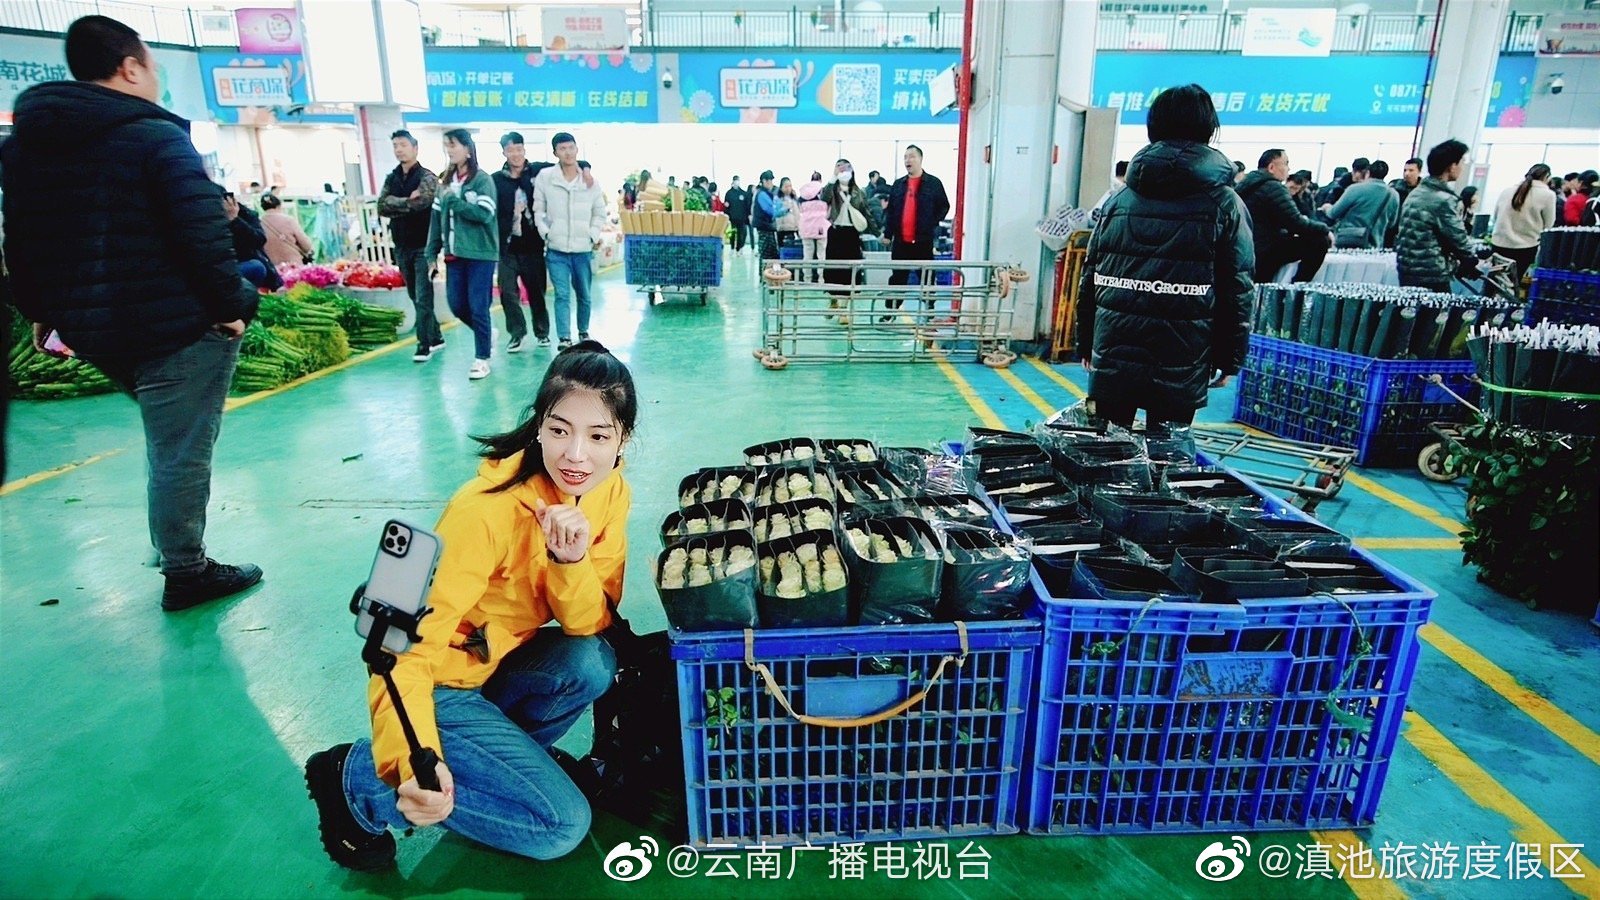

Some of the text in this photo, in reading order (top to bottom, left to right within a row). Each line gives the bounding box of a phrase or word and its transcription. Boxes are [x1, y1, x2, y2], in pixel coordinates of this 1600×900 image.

[893, 68, 938, 85] 买卖用
[514, 91, 577, 108] 收支清晰
[587, 90, 649, 108] 在线结算
[1256, 92, 1332, 113] 发货无忧
